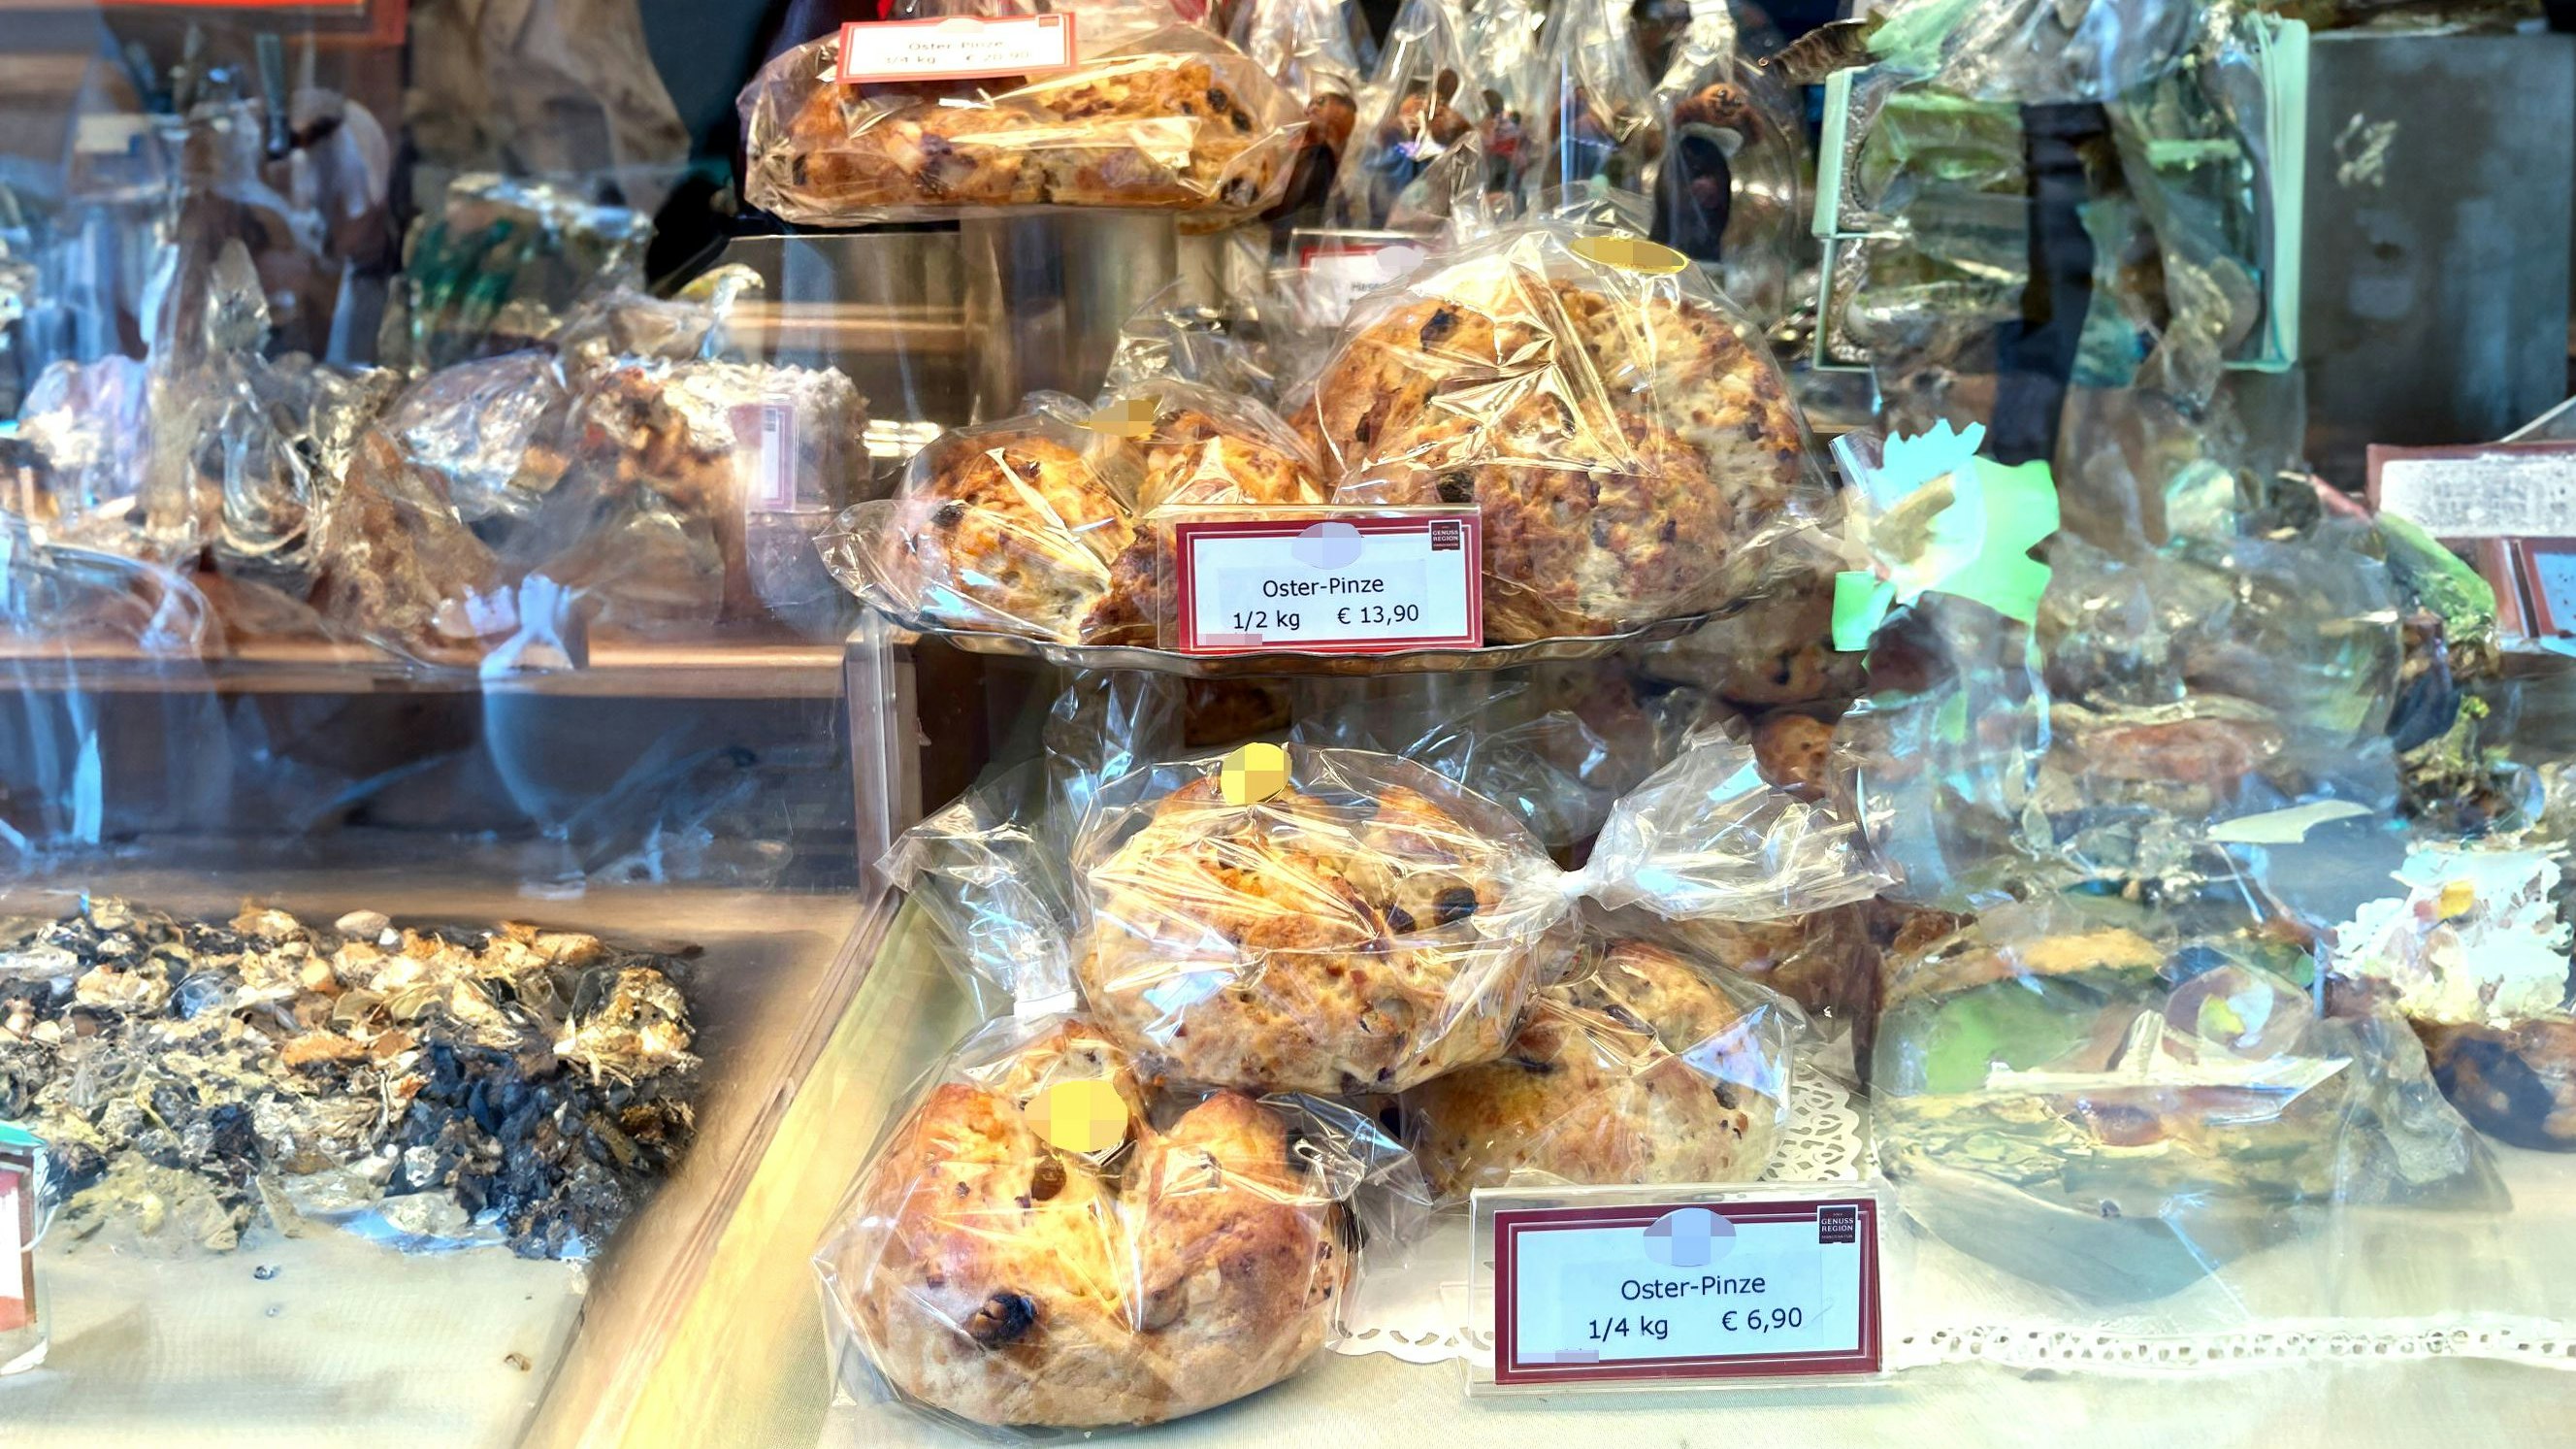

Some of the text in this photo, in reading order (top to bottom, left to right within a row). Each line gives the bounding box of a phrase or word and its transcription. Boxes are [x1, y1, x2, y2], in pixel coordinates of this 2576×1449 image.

[1263, 577, 1385, 598] Oster-Pinze
[1233, 604, 1419, 632] 1/2 kg € 13,90
[1620, 1275, 1766, 1301] Oster-Pinze
[1588, 1306, 1803, 1342] 1/4 kg € 6,90
